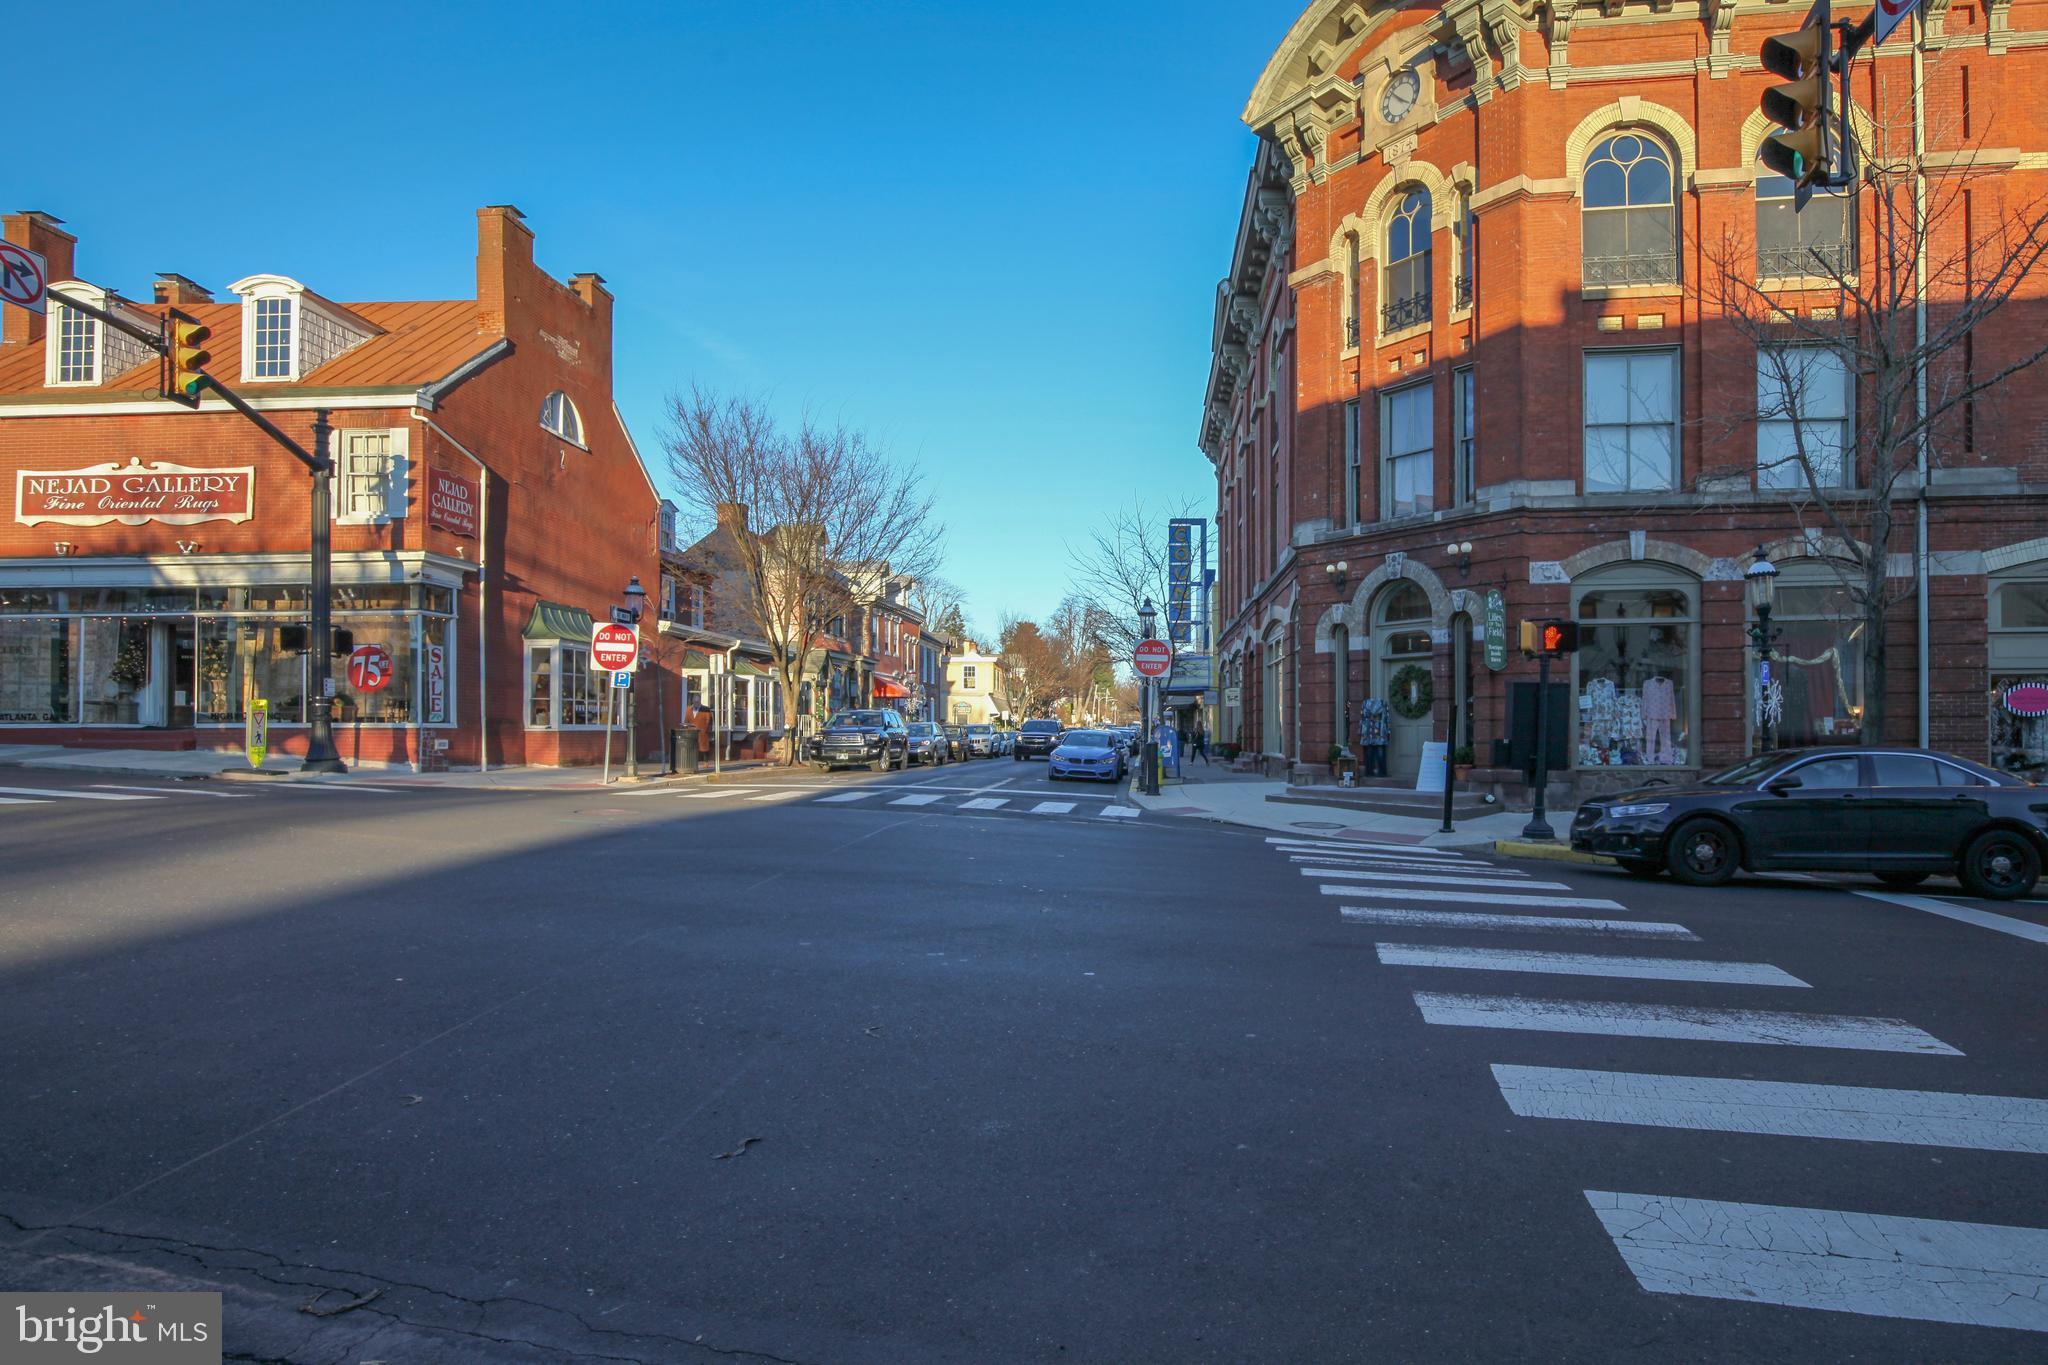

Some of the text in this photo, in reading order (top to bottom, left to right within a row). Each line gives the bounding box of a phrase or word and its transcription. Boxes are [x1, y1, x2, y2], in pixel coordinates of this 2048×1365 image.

[29, 476, 239, 494] NEJAD GALLERY
[439, 479, 468, 499] NEJAD
[43, 495, 220, 512] Fine Oriental Rugs
[432, 493, 473, 516] GALLERY
[1174, 528, 1188, 641] COUNTY
[599, 632, 631, 641] DO NOT
[601, 653, 627, 662] ENTER
[1140, 662, 1163, 670] ENTER
[353, 655, 381, 687] 75
[430, 647, 442, 713] SALE
[618, 673, 627, 683] P
